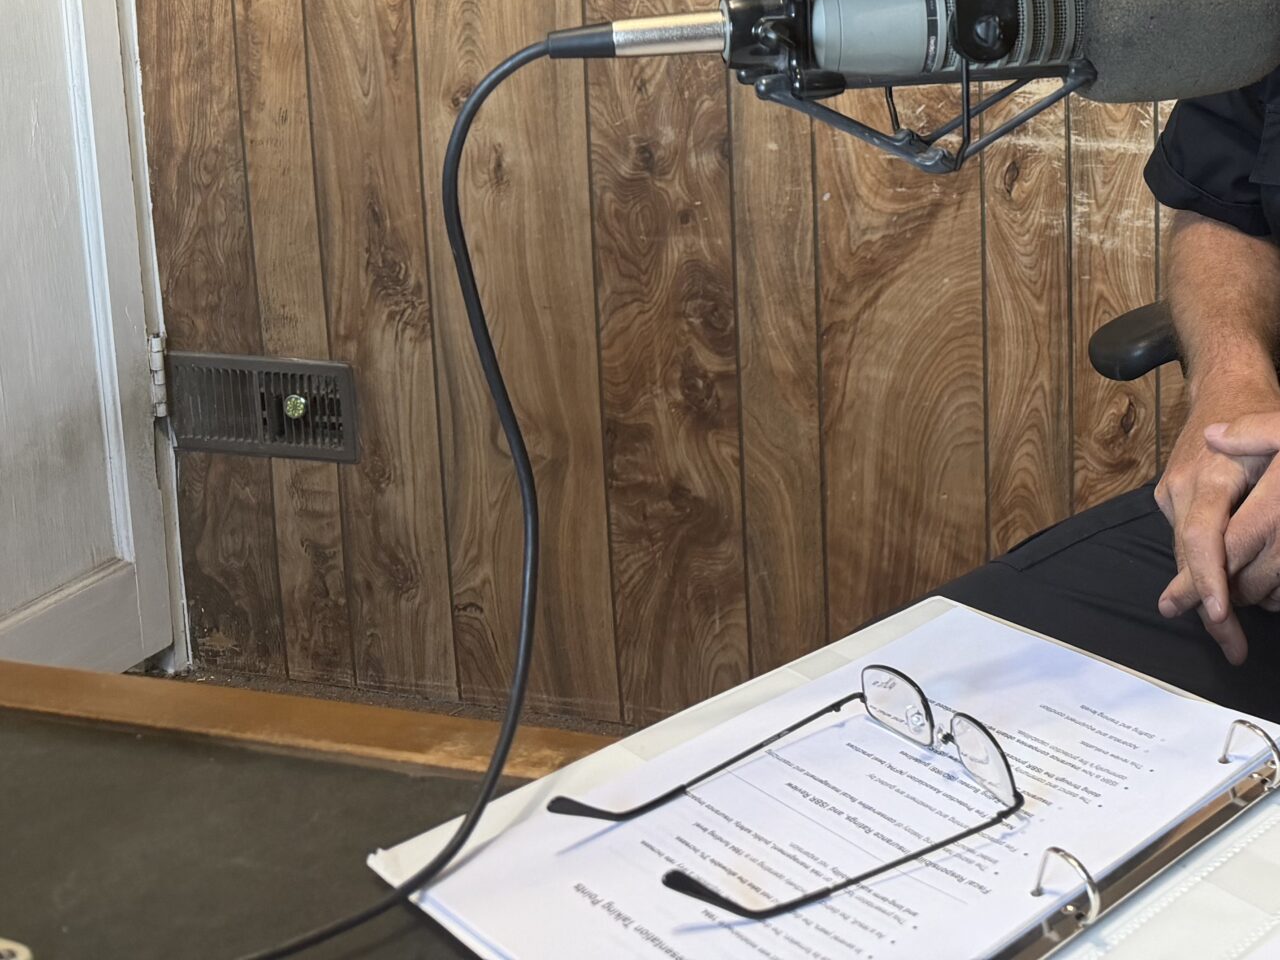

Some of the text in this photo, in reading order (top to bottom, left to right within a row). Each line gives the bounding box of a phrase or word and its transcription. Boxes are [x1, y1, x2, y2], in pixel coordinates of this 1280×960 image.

[841, 741, 876, 758] practices
[1012, 738, 1052, 756] companies
[868, 755, 886, 765] best
[895, 749, 932, 767] guidelines
[1046, 754, 1083, 770] insurance
[781, 781, 812, 798] Review
[800, 770, 844, 793] management
[902, 773, 944, 794] Association
[954, 778, 982, 793] Bureau
[1052, 774, 1083, 789] through
[837, 791, 859, 802] fiscal
[1079, 786, 1103, 798] doing
[806, 795, 830, 808] ISBR
[938, 791, 977, 811] Protection
[825, 806, 845, 816] and
[972, 808, 989, 817] Fire
[704, 829, 734, 847] funding
[749, 832, 773, 845] public
[869, 830, 913, 854] Insurance
[568, 881, 605, 906] Points
[963, 878, 992, 895] Fiscal
[596, 900, 639, 928] Talking
